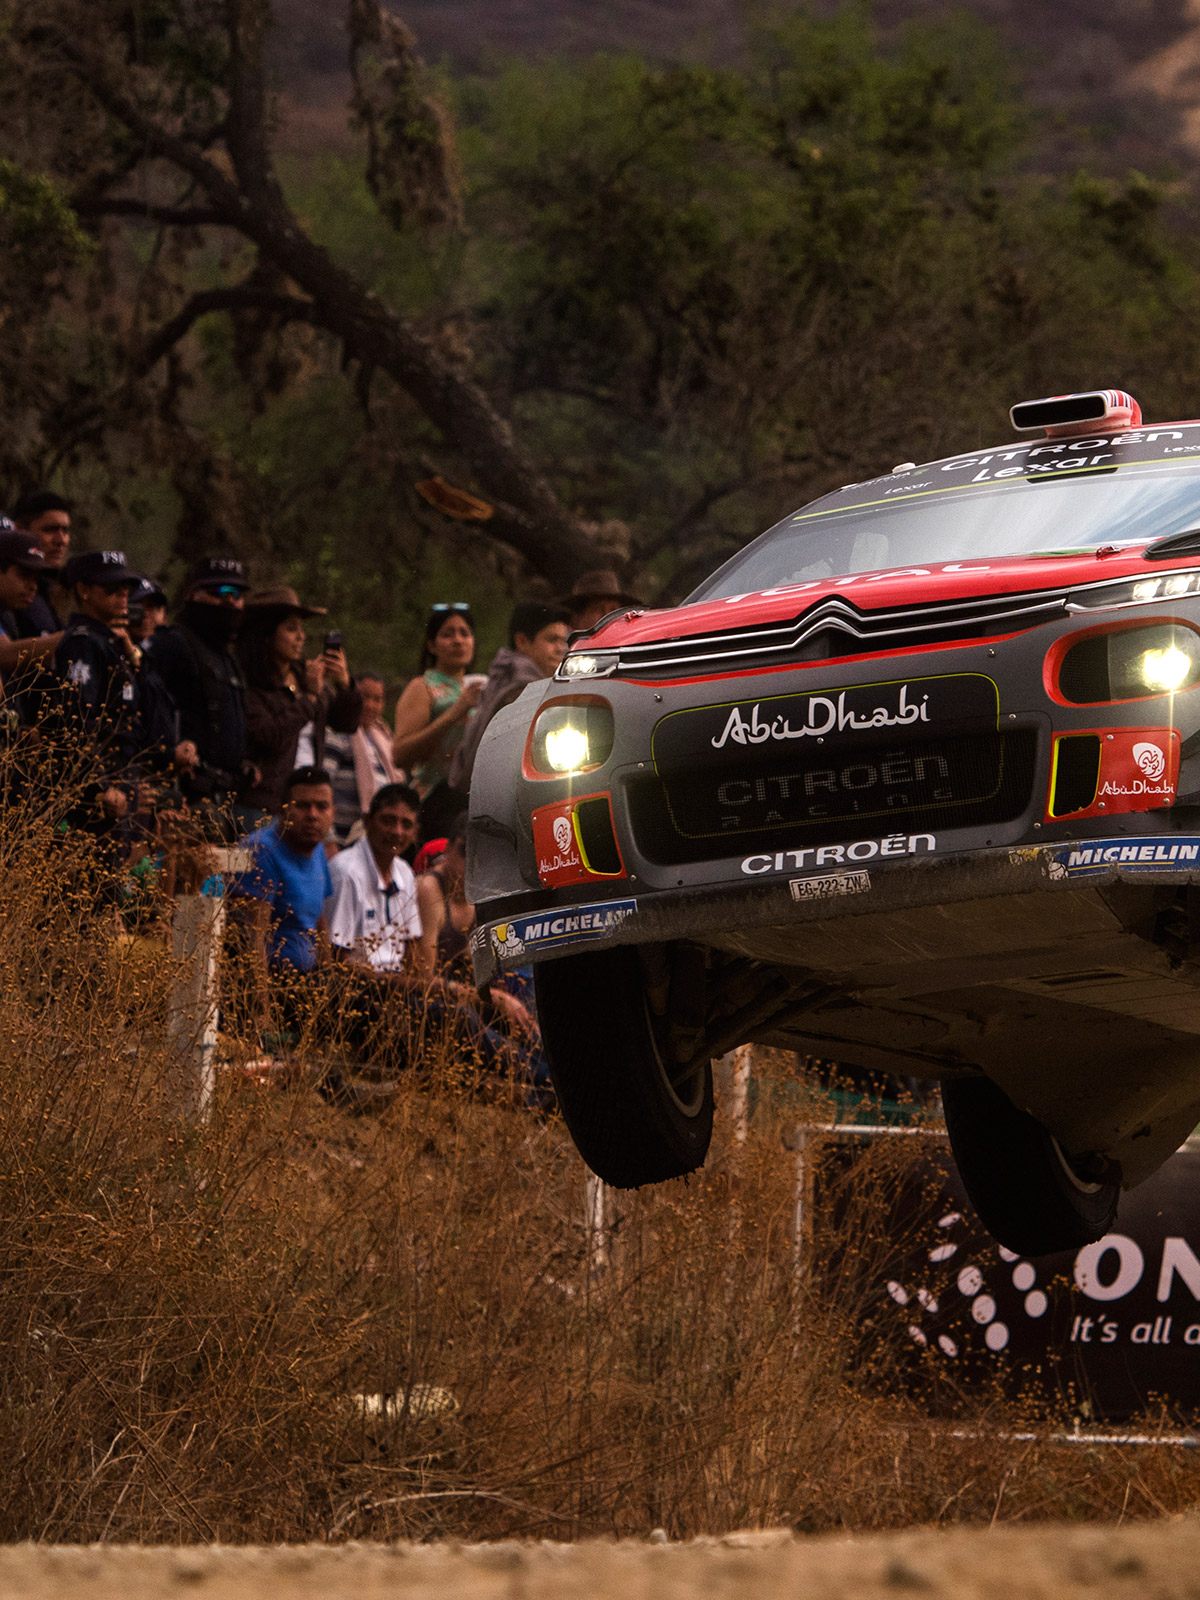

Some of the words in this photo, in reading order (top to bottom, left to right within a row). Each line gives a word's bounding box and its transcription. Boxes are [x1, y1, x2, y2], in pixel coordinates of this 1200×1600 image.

[971, 453, 1113, 483] Lexar
[741, 834, 937, 866] CITROËN
[1068, 845, 1200, 867] MICHELIN
[1130, 1316, 1174, 1344] all
